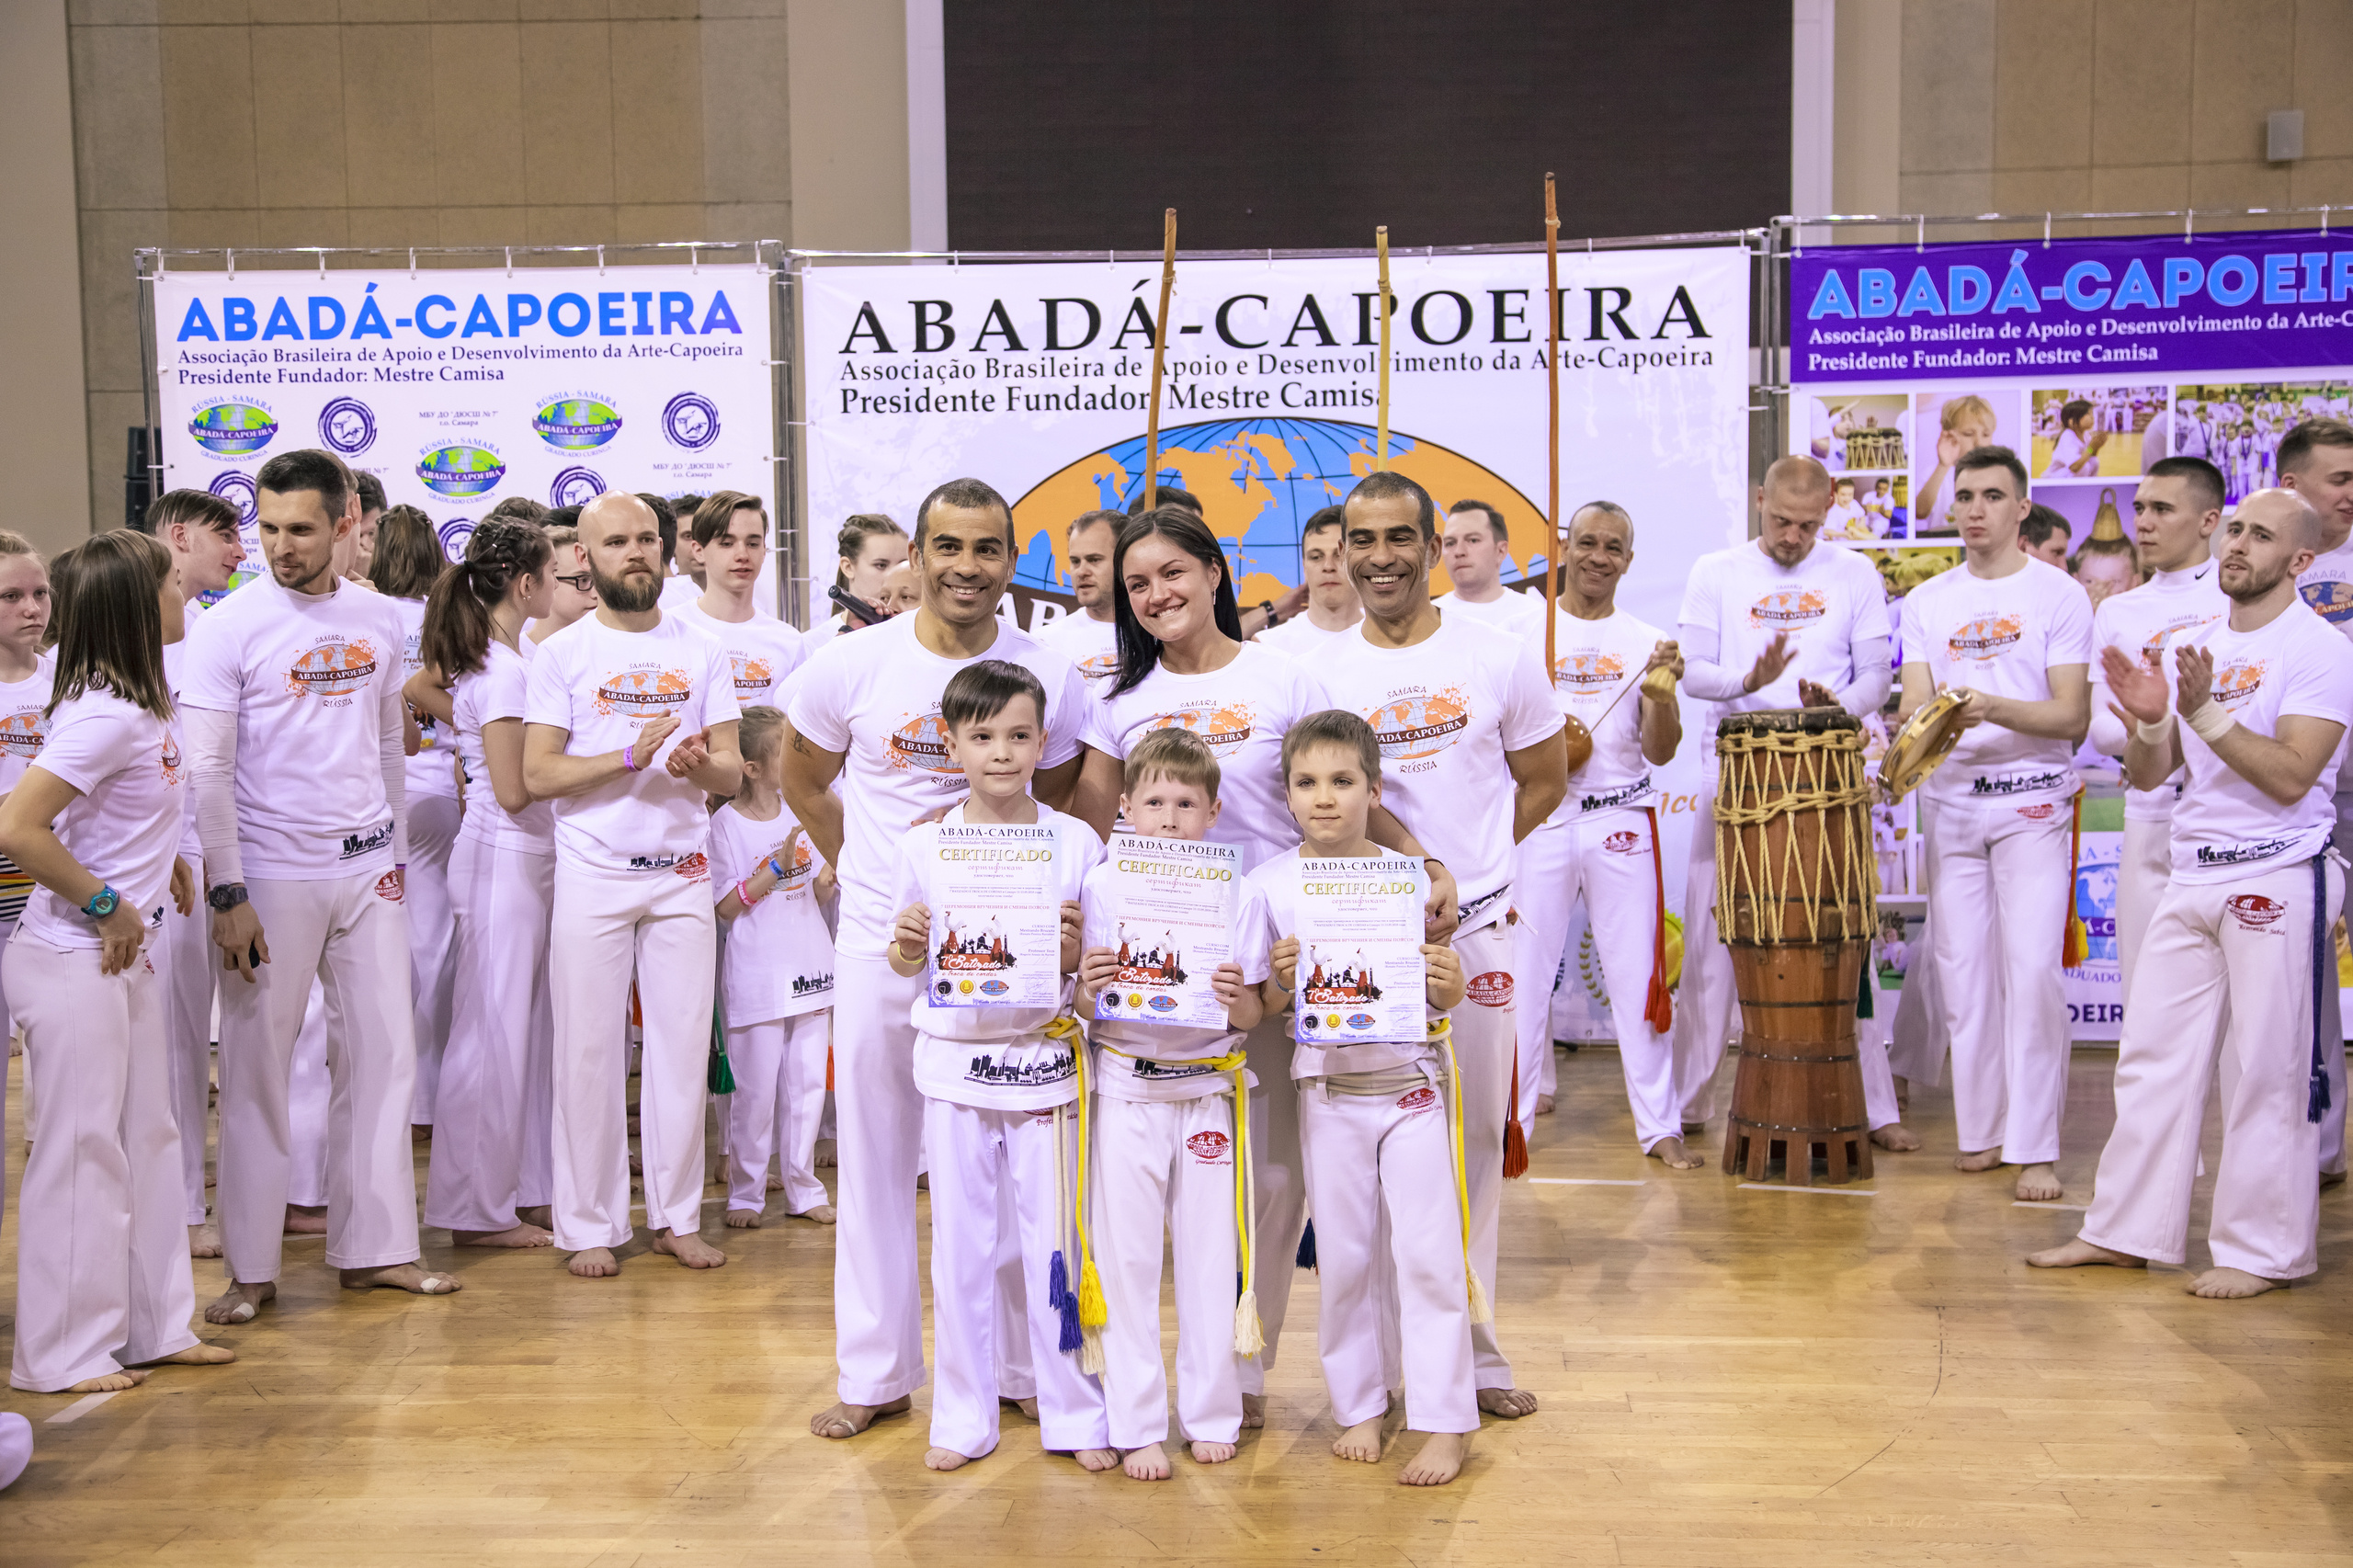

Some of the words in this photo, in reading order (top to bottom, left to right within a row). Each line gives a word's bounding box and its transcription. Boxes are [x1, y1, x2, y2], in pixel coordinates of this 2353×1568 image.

[1807, 248, 2353, 320] ABADÁ-CAPOEIR
[176, 281, 743, 342] ABADÁ-CAPOEIRA
[838, 278, 1713, 354] ABADÁ-CAPOEIRA
[1808, 326, 1905, 347] Associação
[1910, 323, 1995, 343] Brasileira
[1999, 322, 2021, 338] de
[2026, 320, 2082, 342] Apoio
[2086, 324, 2097, 335] e
[2101, 314, 2262, 335] Desenvolvimento
[2267, 312, 2289, 329] da
[178, 348, 268, 367] Associação
[273, 347, 352, 363] Brasileira
[358, 347, 377, 362] de
[382, 346, 432, 365] Apoio
[438, 351, 446, 361] e
[451, 345, 597, 360] Desenvolvimento
[603, 343, 622, 358] da
[628, 341, 744, 360] Arte-Capoeira
[1808, 351, 1908, 371] Presidente
[1913, 347, 2011, 368] Fundador:
[2016, 347, 2082, 365] Mestre
[2086, 343, 2159, 363] Camisa
[840, 358, 976, 385] Associação
[985, 356, 1105, 379] Brasileira
[1114, 356, 1142, 377] de
[1236, 359, 1248, 375] e
[1257, 350, 1483, 375] Desenvolimento
[1493, 349, 1521, 370] da
[178, 369, 271, 385] Presidente
[278, 367, 368, 383] Fundador:
[373, 366, 434, 382] Mestre
[440, 366, 505, 381] Camisa
[191, 396, 225, 414] RÚSSIA
[233, 394, 273, 413] SAMARA
[536, 392, 569, 409] RÚSSIA
[576, 390, 617, 408] SAMARA
[840, 386, 996, 415] Presidente
[1167, 383, 1270, 410] Mestre
[1280, 381, 1392, 409] Camis
[193, 426, 274, 439] ABADÁ-CAPOEIRA
[537, 422, 619, 435] ABADÁ-CAPOEIRA
[419, 438, 453, 456] RÚSSIA
[460, 437, 501, 455] SAMARA
[420, 469, 502, 482] ABADÁ-CAPOEIRA
[314, 634, 346, 644] SAMARA
[297, 666, 372, 680] ABADÁ-CAPOEIRA
[629, 662, 662, 670] SAMARA
[1555, 672, 1620, 682] BADÁ-CAPOEIRA
[603, 690, 686, 703] ABADÁ-CAPOEIRA
[1387, 685, 1427, 699] SAMARA
[323, 698, 353, 708] RÚSSIA
[1180, 699, 1218, 709] SAMARA
[1376, 721, 1463, 744] ADÁ-CAPOEIRA
[1399, 761, 1438, 774] RÚSSIA
[938, 826, 1053, 837] ABADÁ-CAPOEIRA
[939, 848, 1052, 862] CERTIFICADO
[1118, 838, 1235, 858] ABADÁ-CAPOEIRA
[1118, 859, 1233, 881] CERTIFICADO
[1302, 860, 1416, 871] ABADÁ-CAPOEIRA
[1303, 881, 1415, 895] CERTIFICADO
